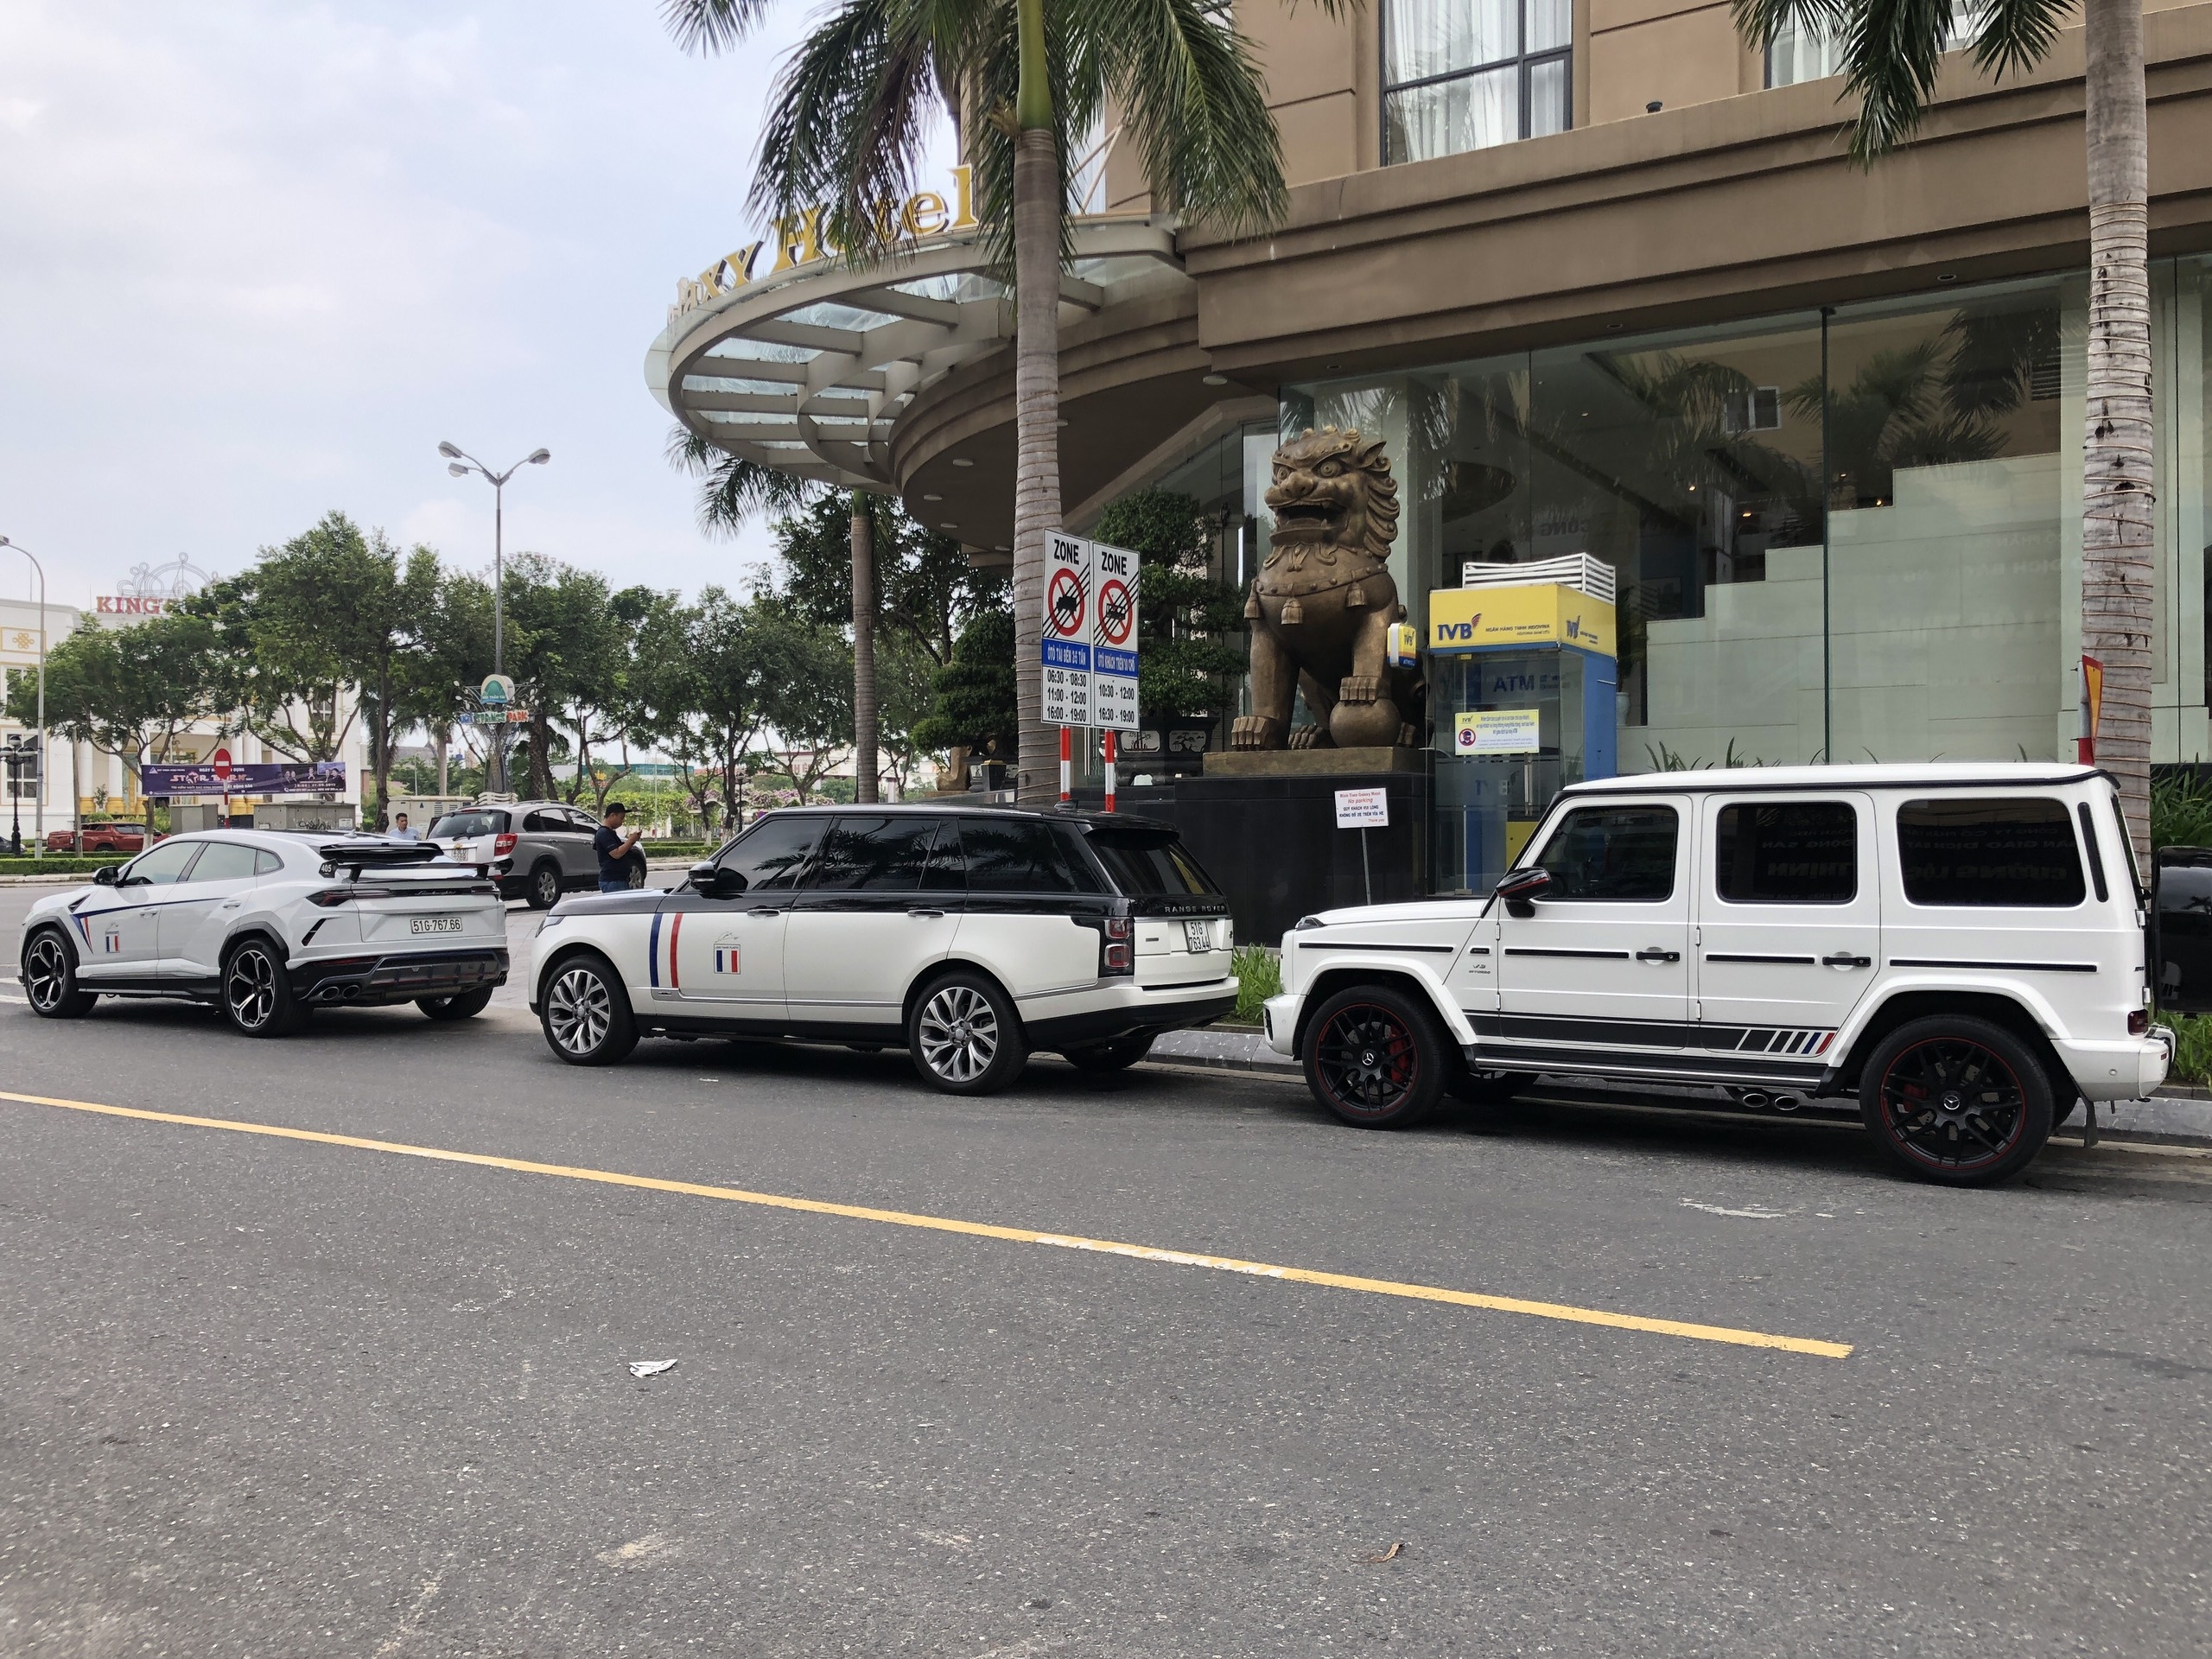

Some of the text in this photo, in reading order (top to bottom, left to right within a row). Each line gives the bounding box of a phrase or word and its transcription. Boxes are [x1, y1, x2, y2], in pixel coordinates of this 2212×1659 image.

[1053, 538, 1080, 566] ZONE
[1101, 550, 1128, 577] ZONE
[96, 596, 164, 614] KING'
[1437, 623, 1472, 641] IVB
[1047, 669, 1064, 684] 06:30
[1070, 672, 1086, 687] 08:30
[1492, 674, 1535, 692] ATM
[1047, 687, 1064, 702] 11:00
[1071, 690, 1086, 705] 12:00
[1098, 683, 1114, 698] 10:30
[1120, 686, 1135, 701] 12:00
[1047, 705, 1064, 720] 16:00
[1071, 708, 1086, 722] 19:00
[1098, 707, 1114, 721] 16:30
[1120, 709, 1135, 723] 19:00
[321, 864, 332, 873] 405
[412, 918, 461, 932] 51G-767.66
[1190, 921, 1203, 936] 51G
[1188, 936, 1210, 950] 763.44
